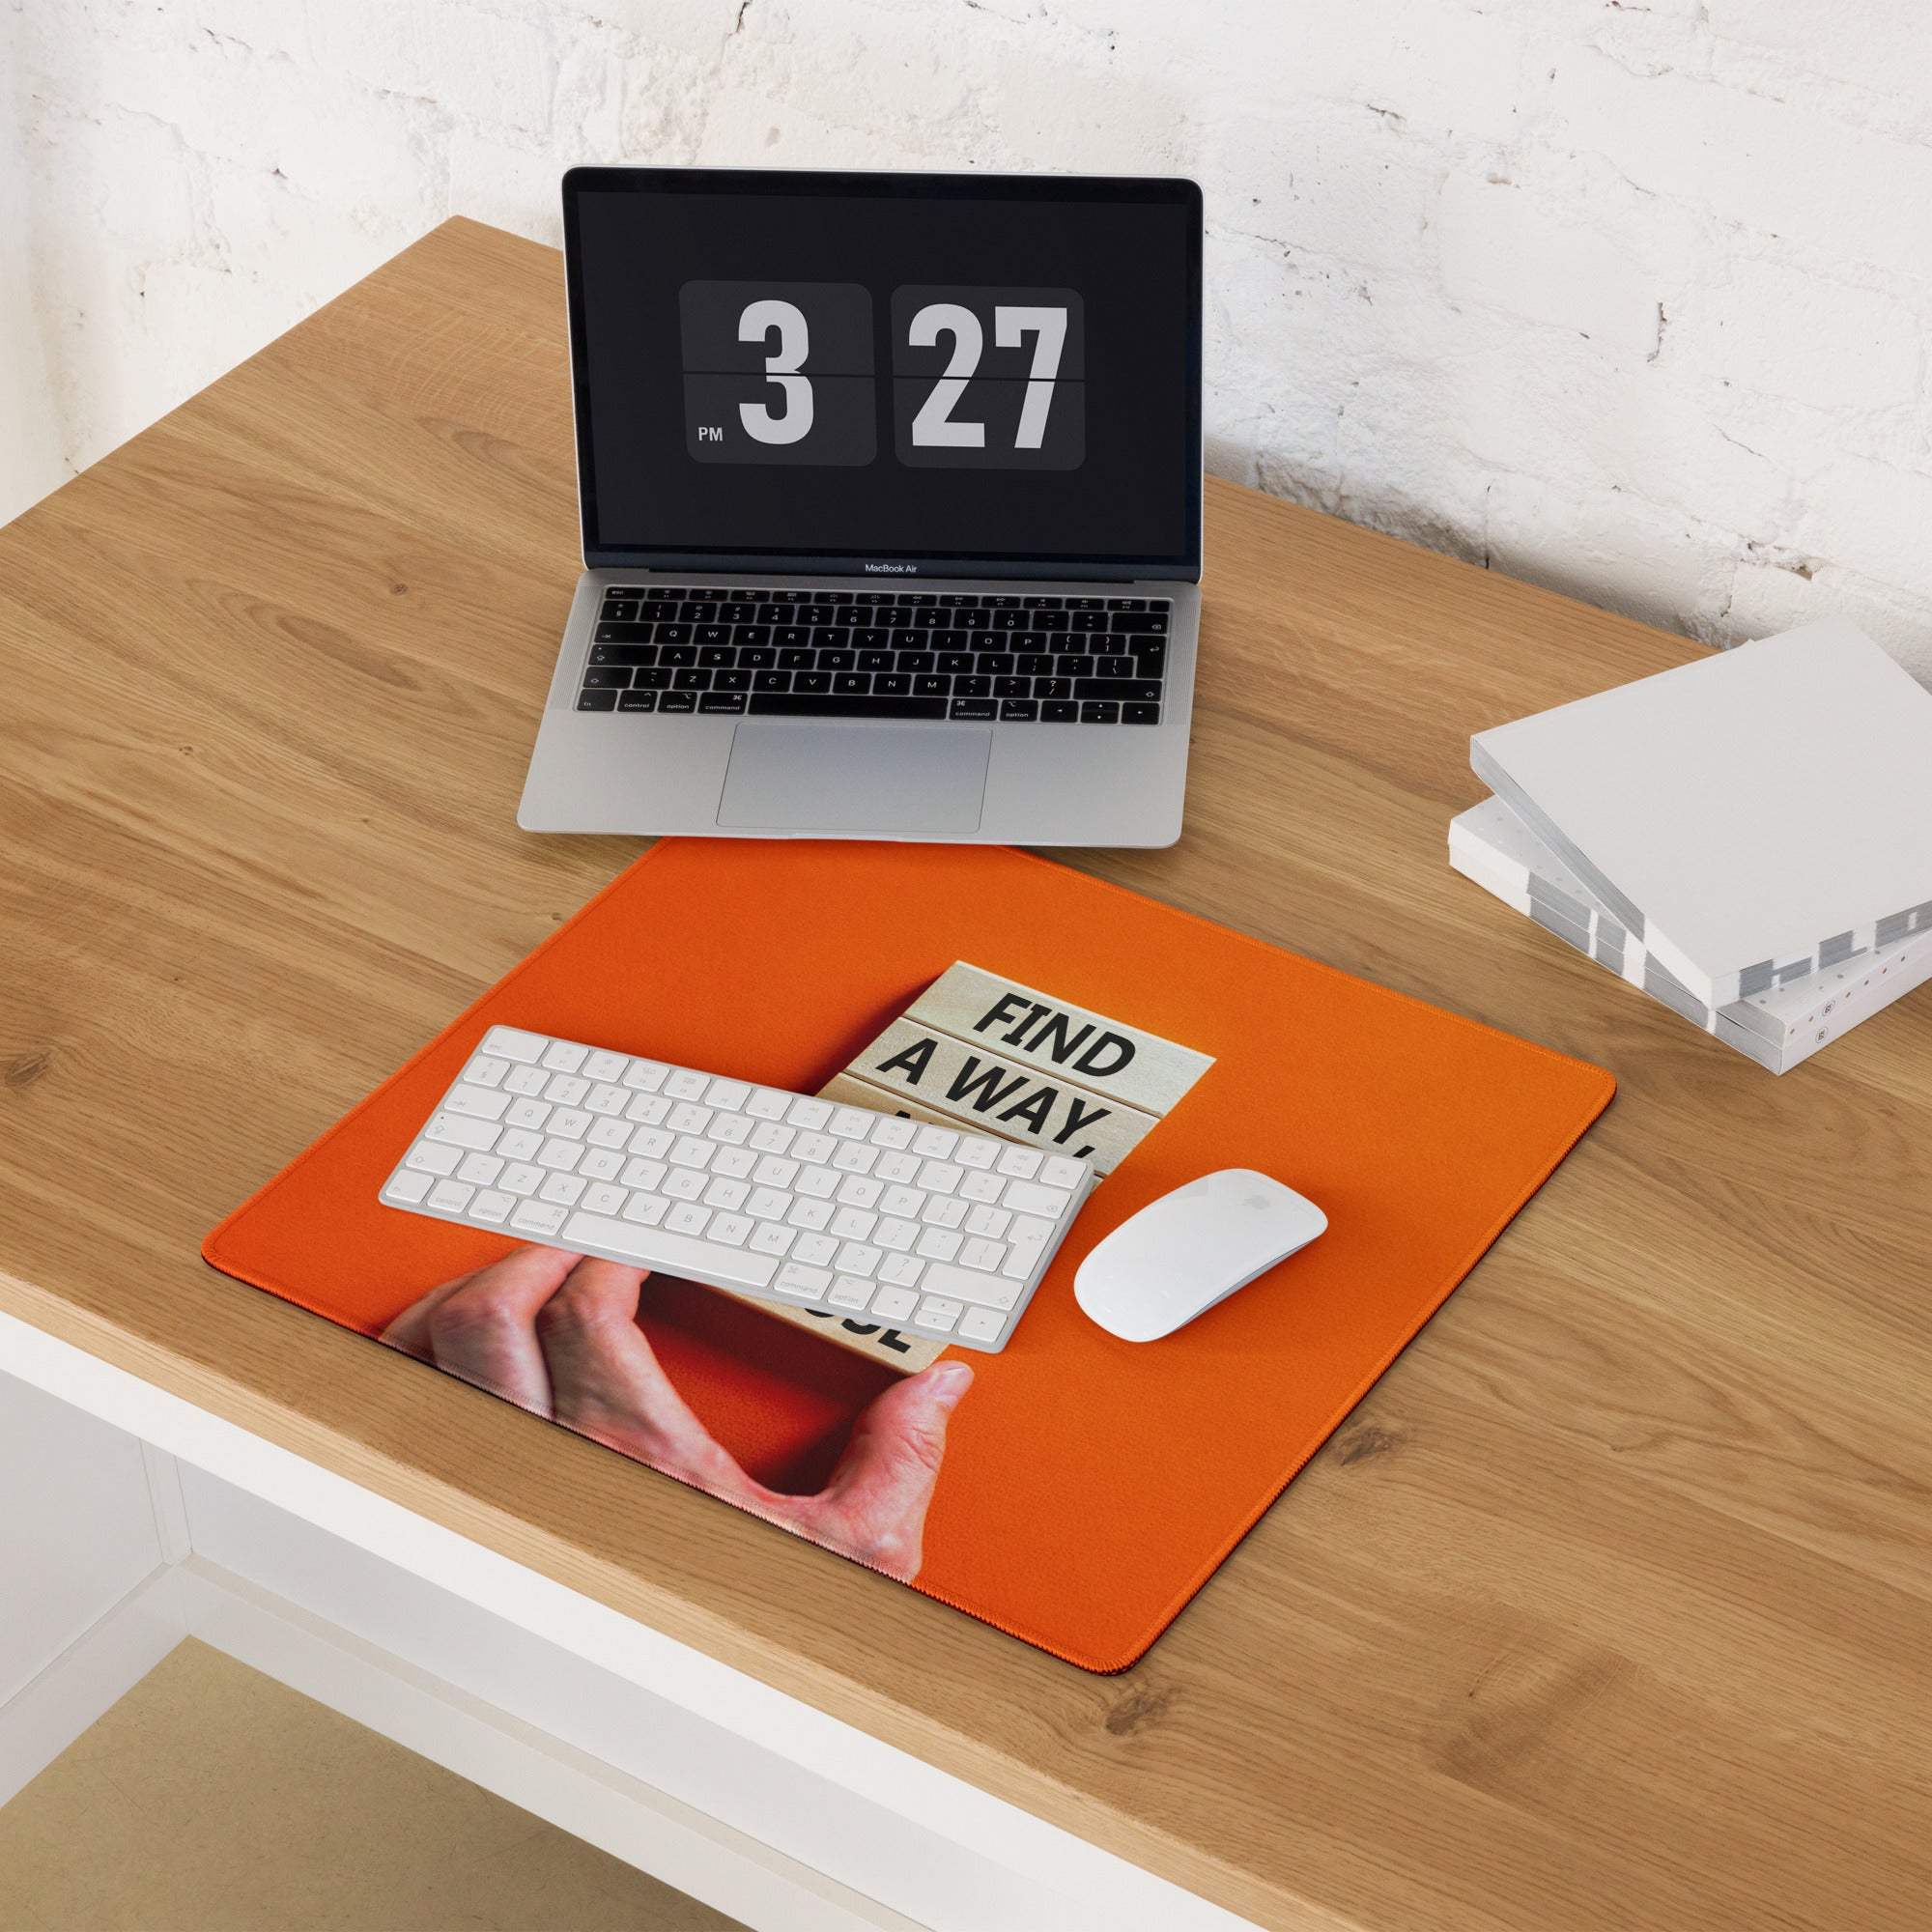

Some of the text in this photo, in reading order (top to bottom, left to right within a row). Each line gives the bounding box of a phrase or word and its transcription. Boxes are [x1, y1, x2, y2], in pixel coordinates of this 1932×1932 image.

[738, 299, 1067, 449] 3 27
[697, 427, 724, 441] PM
[866, 563, 918, 573] MacBook Air
[973, 992, 1136, 1077] FIND
[875, 1037, 1112, 1158] A WAY,
